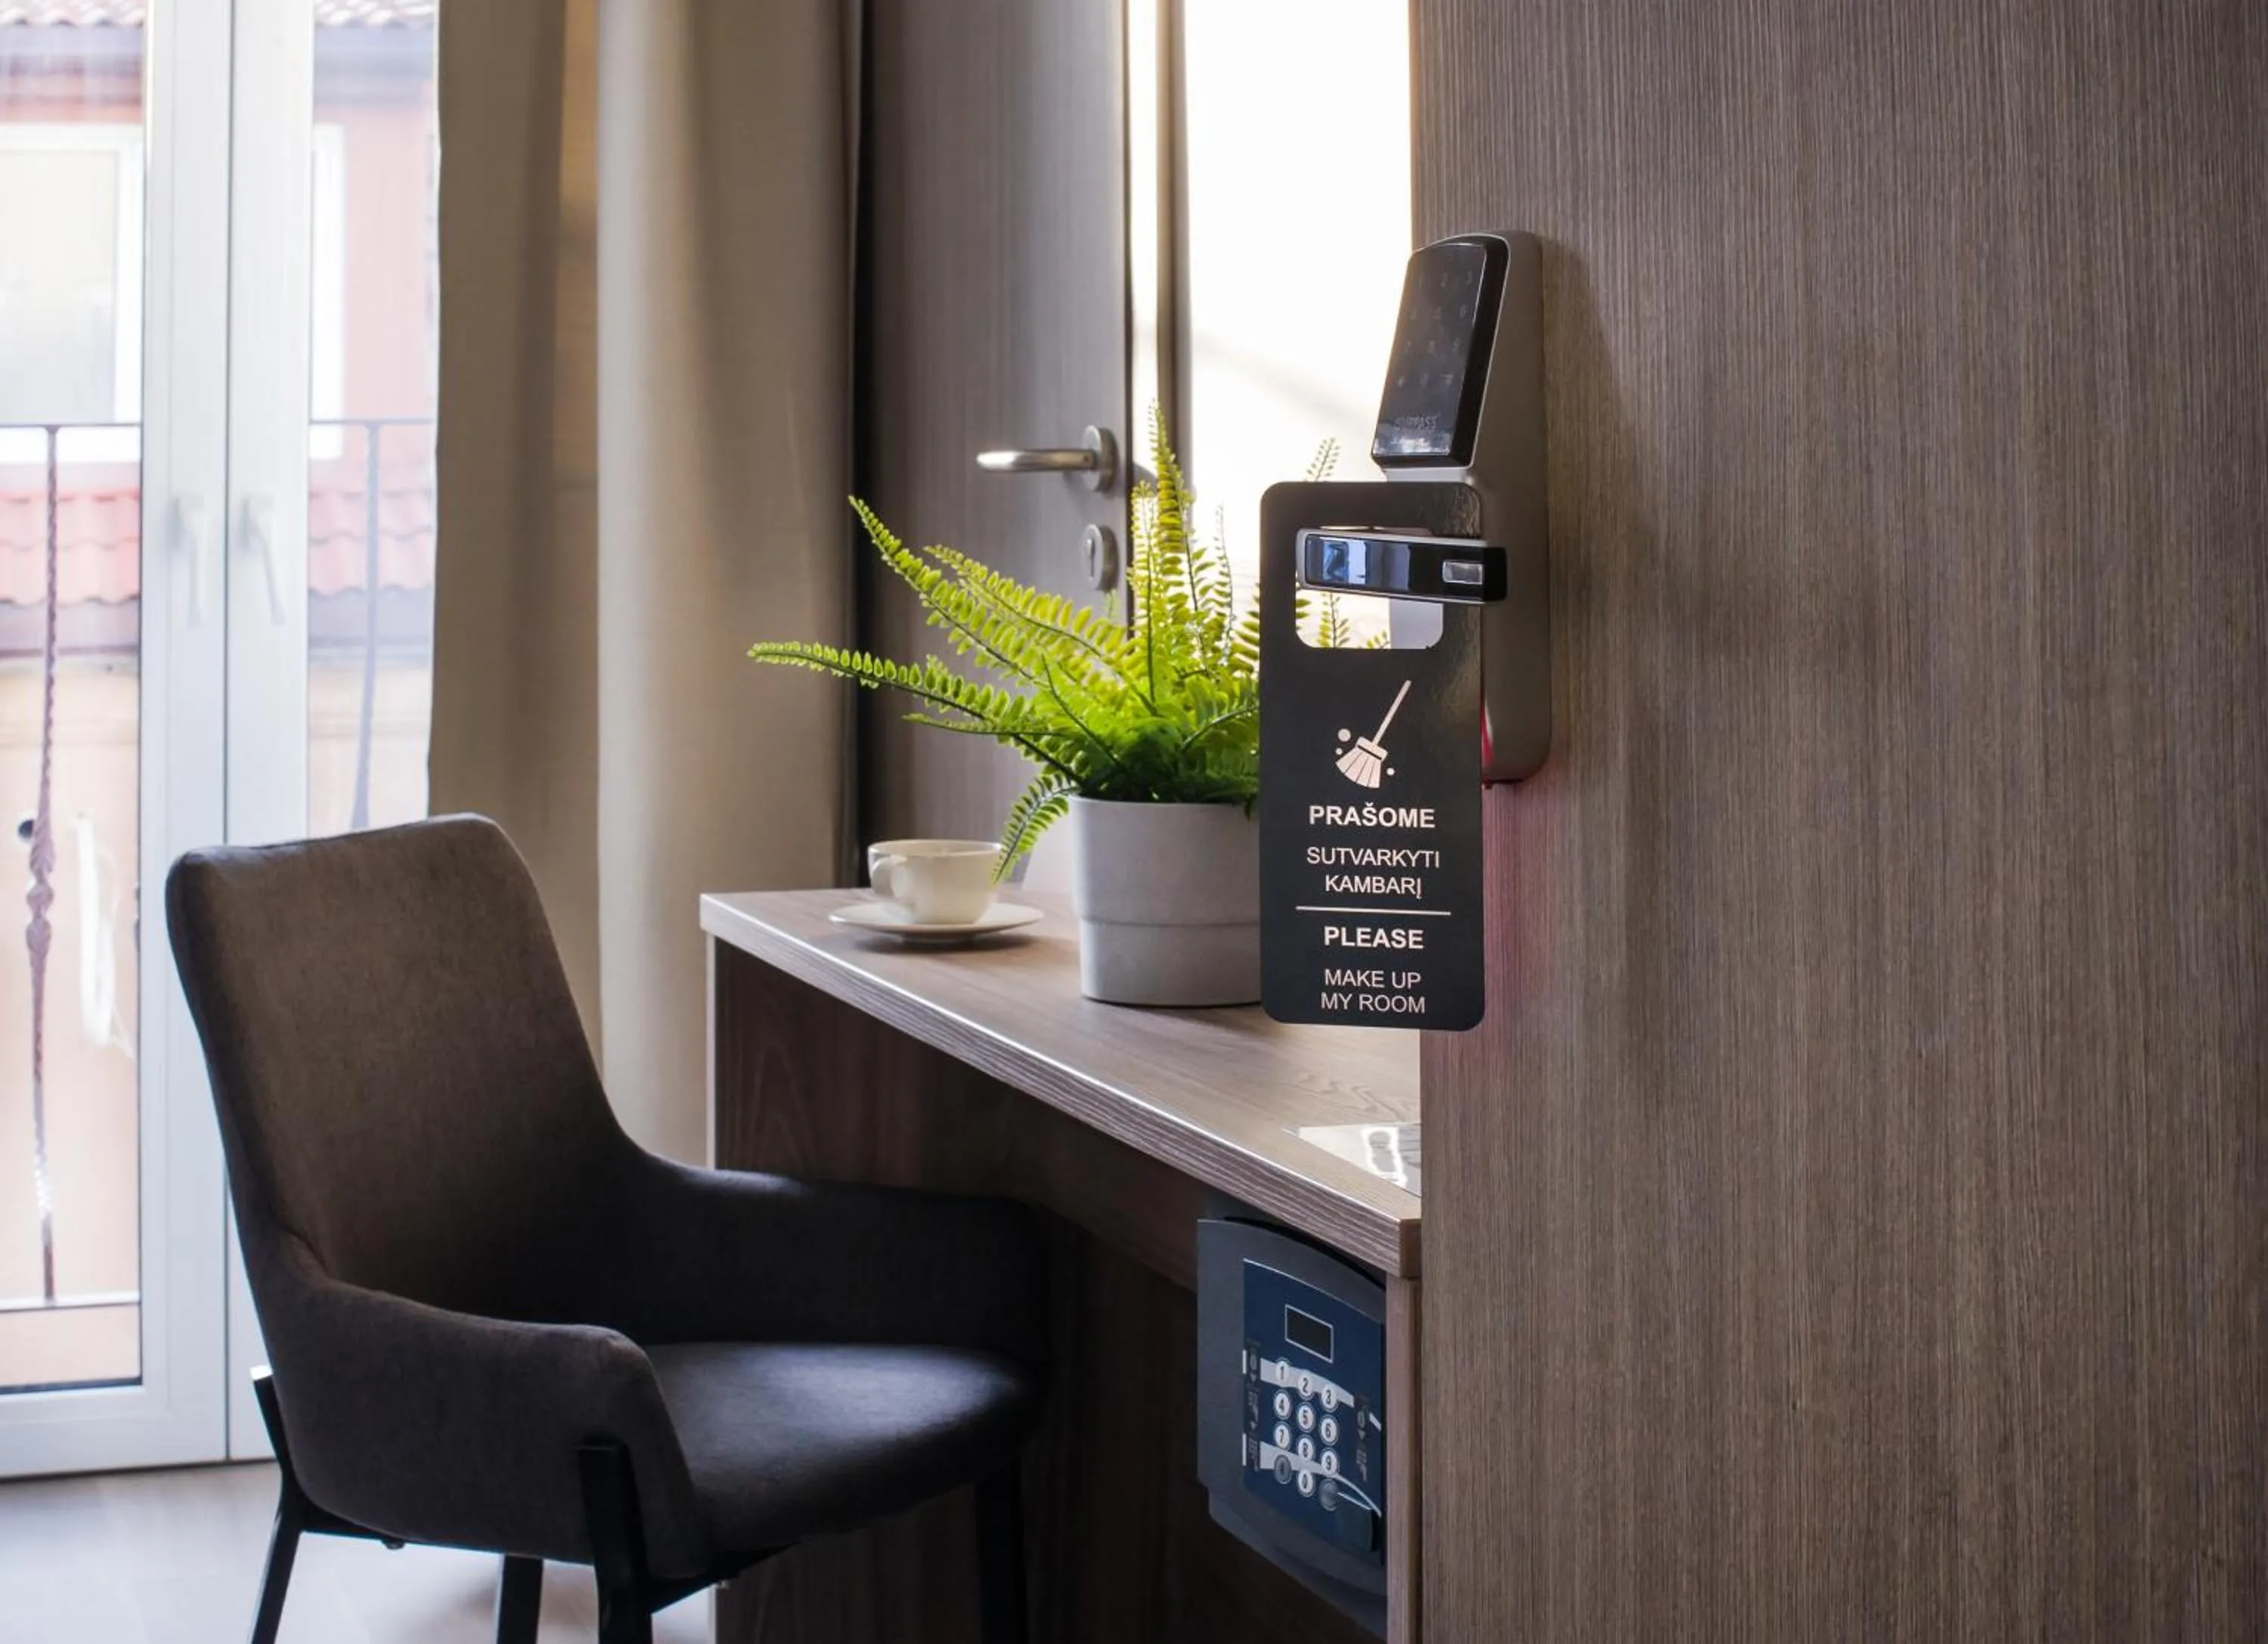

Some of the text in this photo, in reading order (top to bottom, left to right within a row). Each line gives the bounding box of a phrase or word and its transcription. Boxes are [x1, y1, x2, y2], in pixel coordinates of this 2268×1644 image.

[1309, 802, 1435, 828] PRAŠOME
[1307, 847, 1439, 868] SUTVARKYTI
[1325, 874, 1421, 899] KAMBARĮ
[1325, 926, 1424, 949] PLEASE
[1325, 969, 1421, 988] MAKE UP
[1321, 992, 1424, 1013] MY ROOM
[1279, 1365, 1332, 1405] 1 2 3
[1278, 1397, 1332, 1438] 4 5 6
[1302, 1441, 1309, 1459] 8
[1325, 1454, 1332, 1472] 9
[1300, 1473, 1309, 1490] 0
